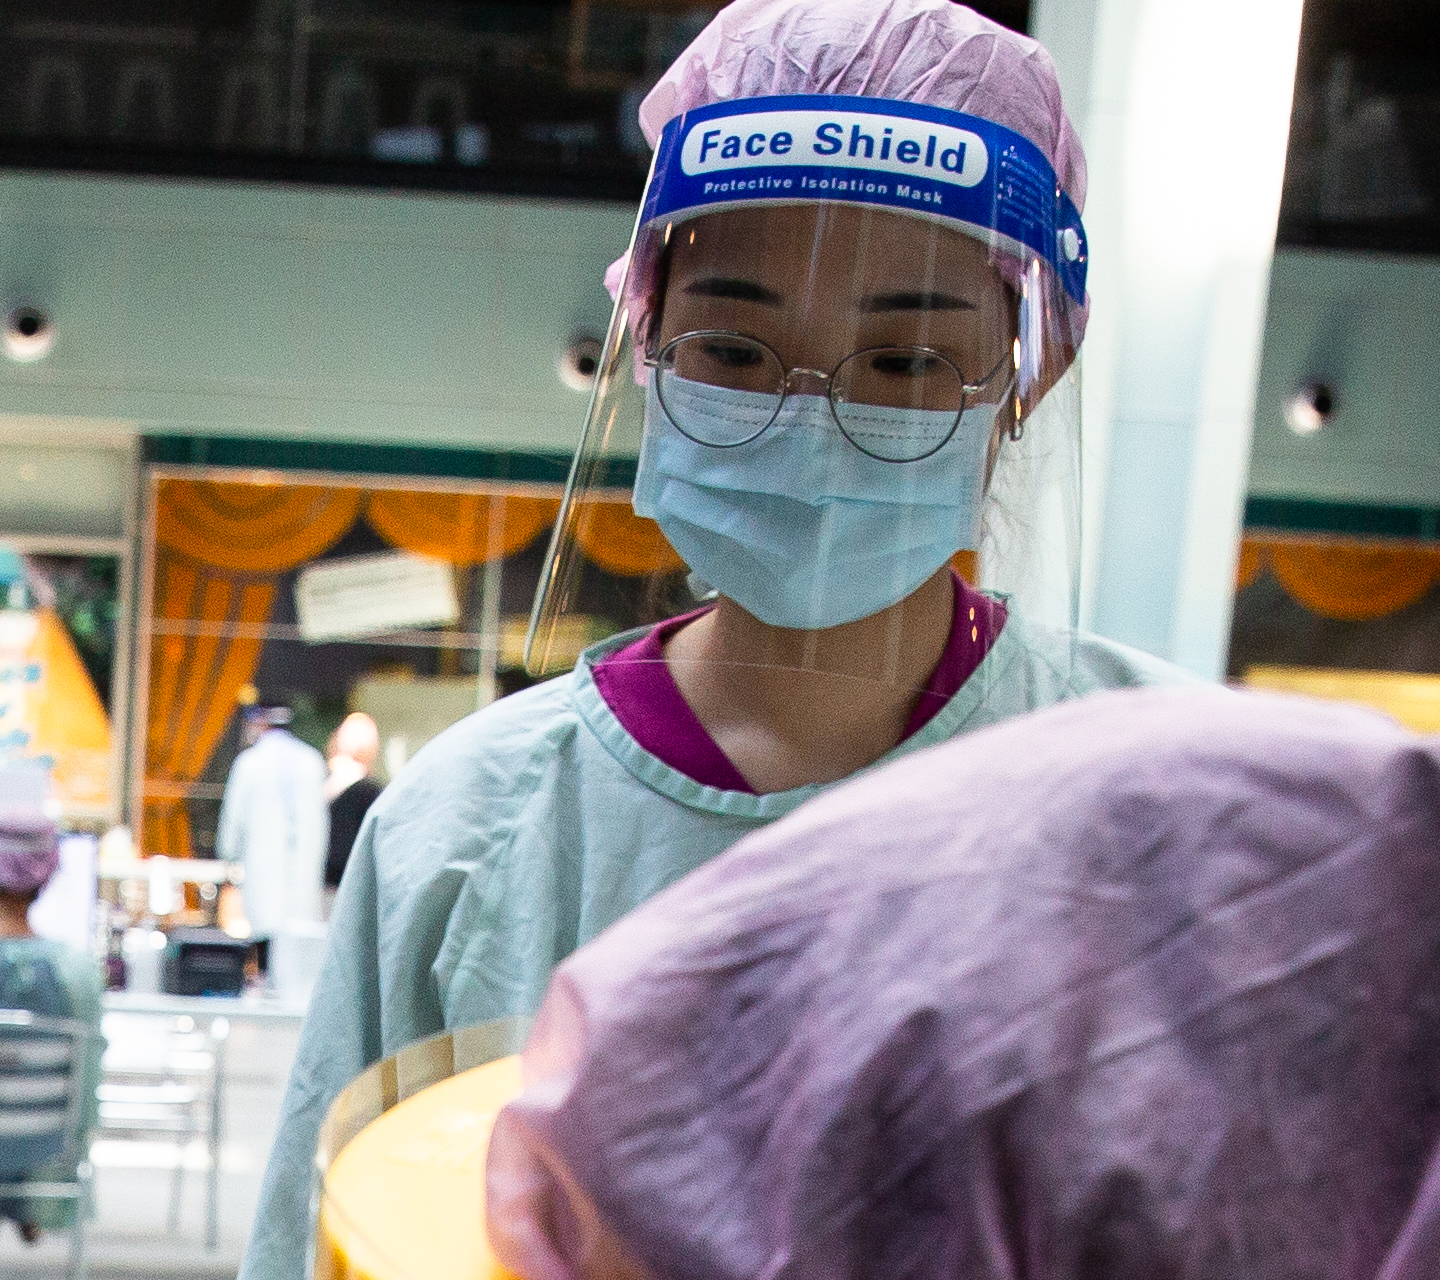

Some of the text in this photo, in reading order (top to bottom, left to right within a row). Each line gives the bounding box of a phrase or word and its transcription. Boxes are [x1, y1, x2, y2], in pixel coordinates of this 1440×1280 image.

[698, 122, 968, 175] Face Shield
[704, 175, 944, 205] Protective Isolation Mask
